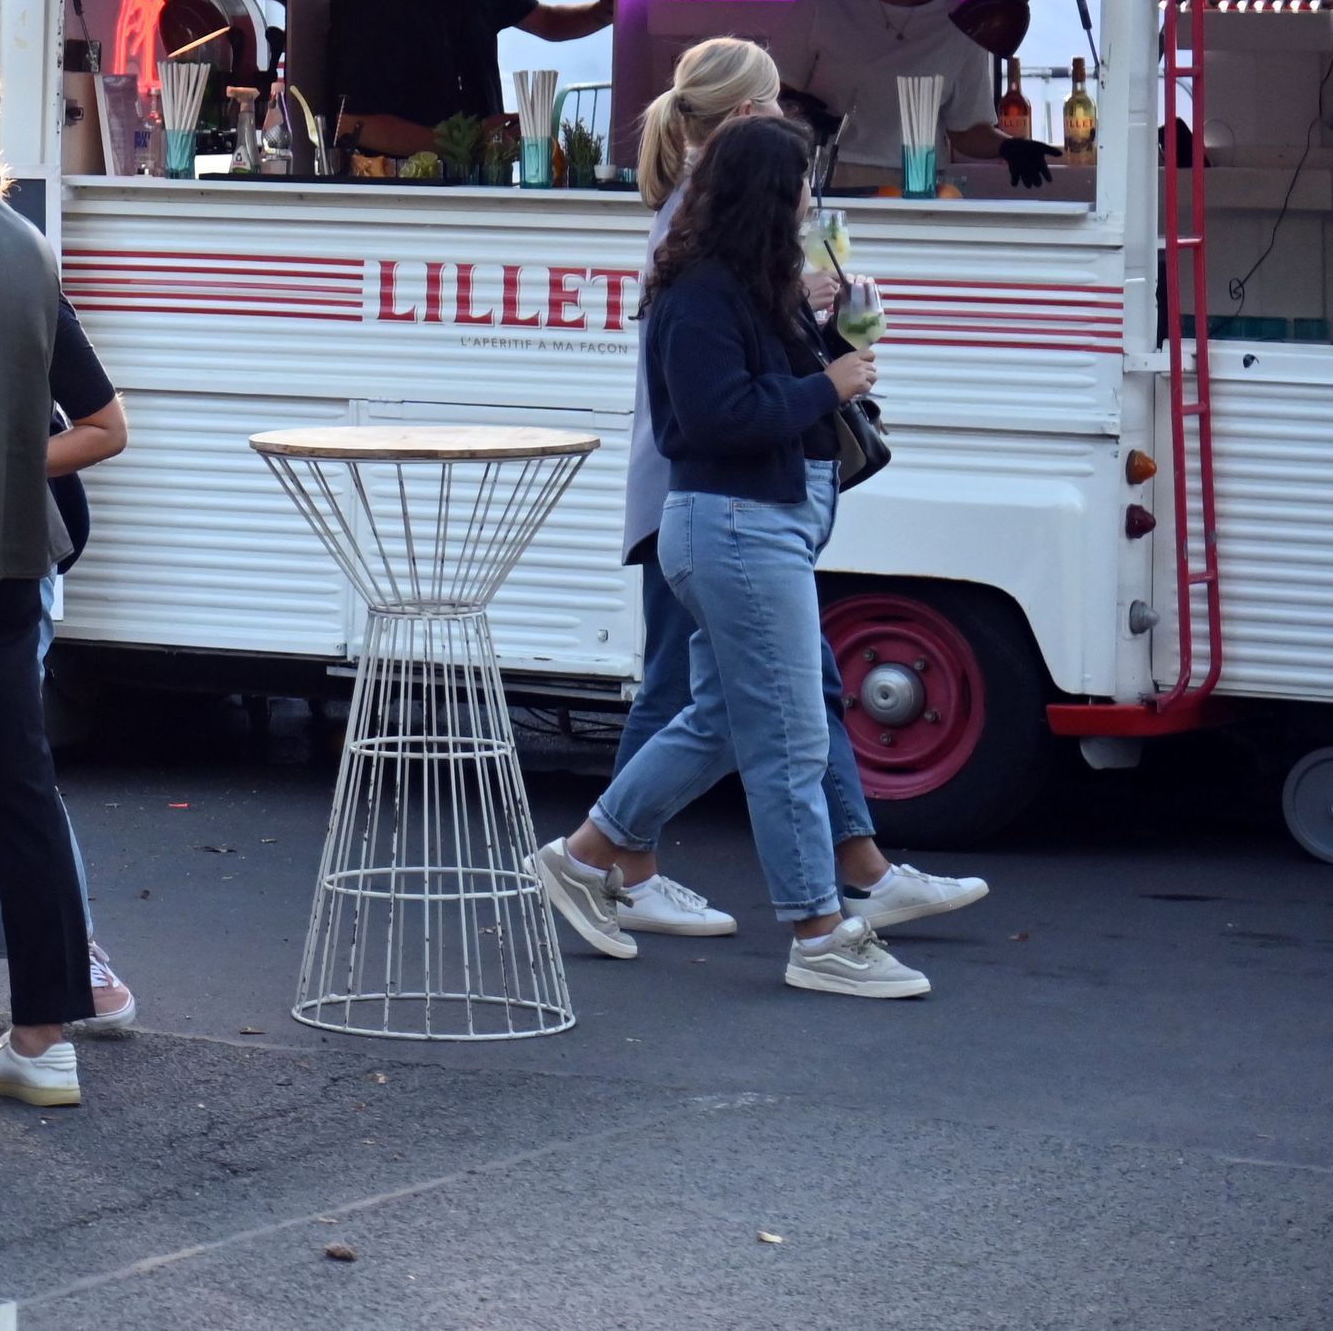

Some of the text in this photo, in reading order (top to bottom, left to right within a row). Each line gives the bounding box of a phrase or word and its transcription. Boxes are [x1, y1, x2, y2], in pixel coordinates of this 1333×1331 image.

[376, 260, 644, 333] LILLET
[552, 341, 574, 352] MA
[580, 342, 629, 355] FAÇON
